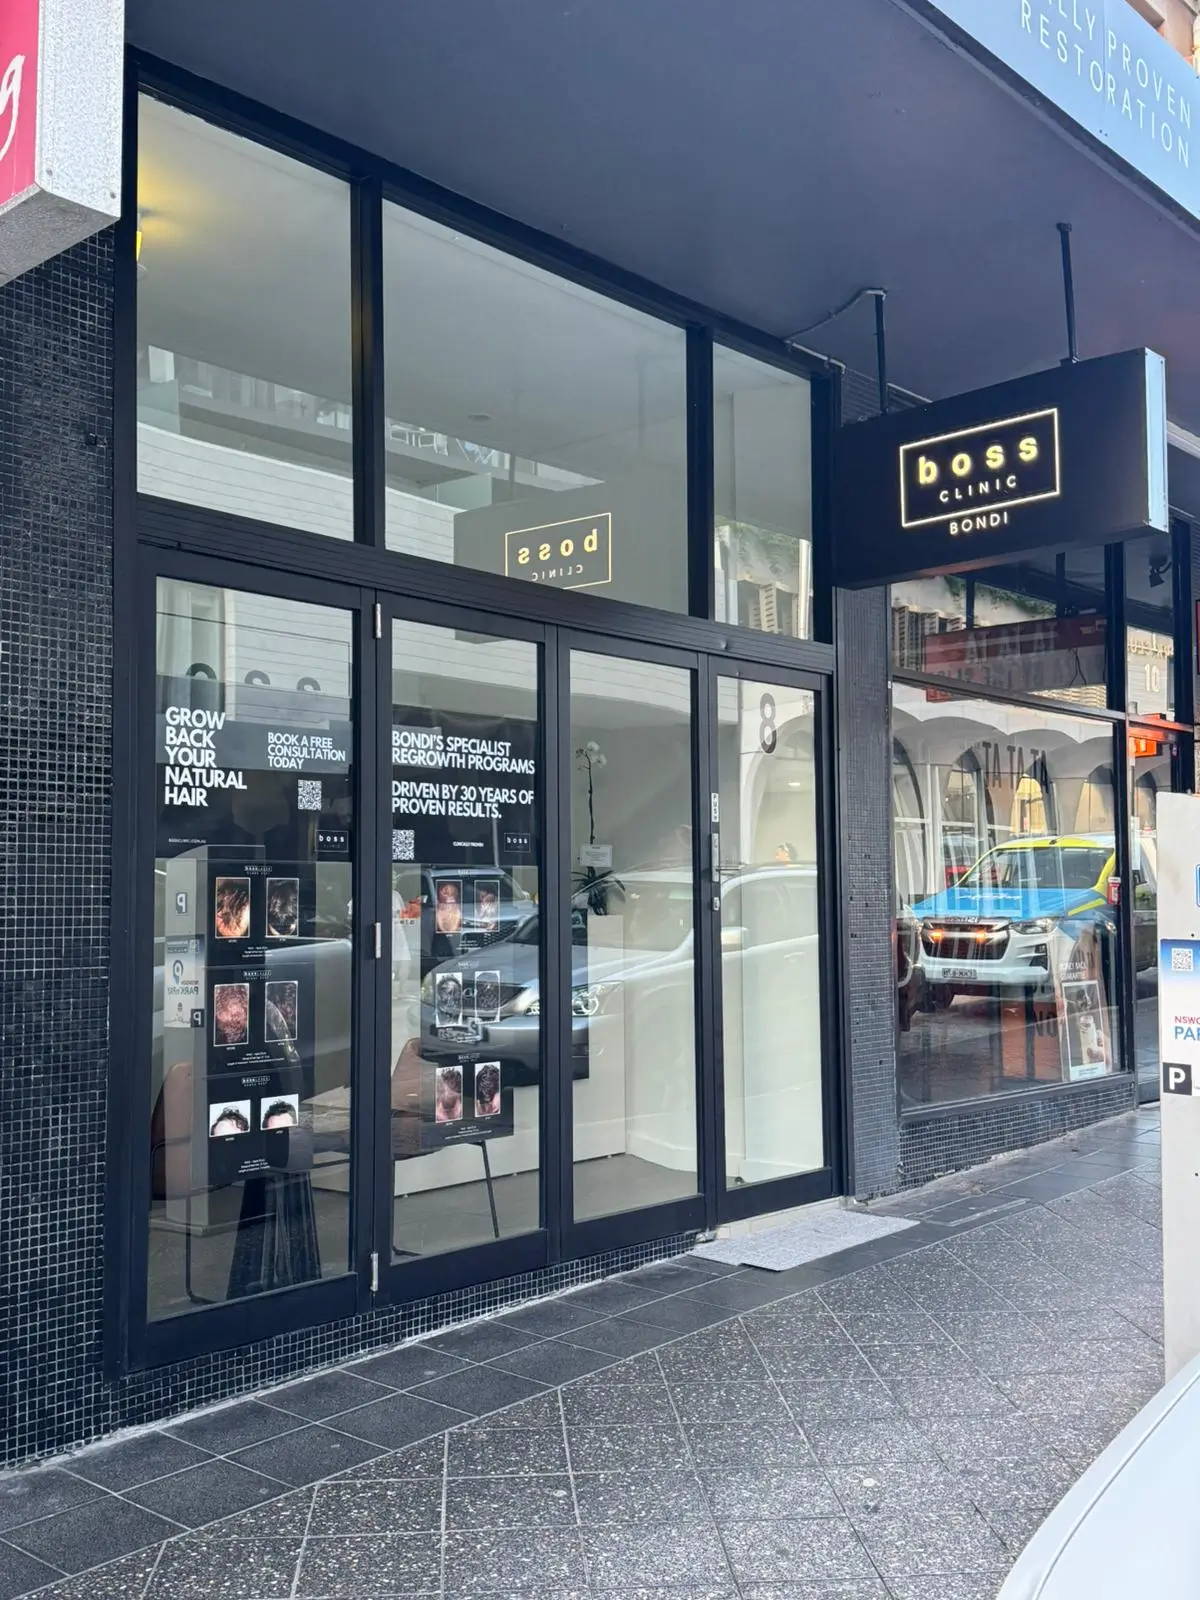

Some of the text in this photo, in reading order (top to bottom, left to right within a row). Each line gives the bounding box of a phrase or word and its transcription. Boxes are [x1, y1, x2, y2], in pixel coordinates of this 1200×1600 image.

[1021, 0, 1189, 169] RESTORATION
[1108, 30, 1191, 131] PROVEN
[917, 436, 1039, 485] boss
[939, 475, 1018, 503] CLINIC
[949, 511, 1009, 535] BONDI
[1144, 663, 1161, 693] 10
[165, 706, 226, 730] GROW
[760, 692, 777, 754] 8
[165, 727, 216, 749] BACK
[267, 732, 333, 749] BOOK A FREE
[392, 731, 511, 757] BONDI'S SPECIALIST
[165, 746, 217, 769] YOUR
[267, 744, 346, 762] CONSULTATION
[267, 756, 304, 769] TODAY
[392, 748, 535, 775] REGROWTH PROGRAMS
[165, 767, 248, 790] NATURAL
[165, 786, 209, 807] HAIR
[392, 780, 534, 805] DRIVEN BY 30 YEARS OF
[392, 798, 502, 819] PROVEN RESULTS.
[318, 834, 345, 843] boss
[1168, 1067, 1186, 1090] P
